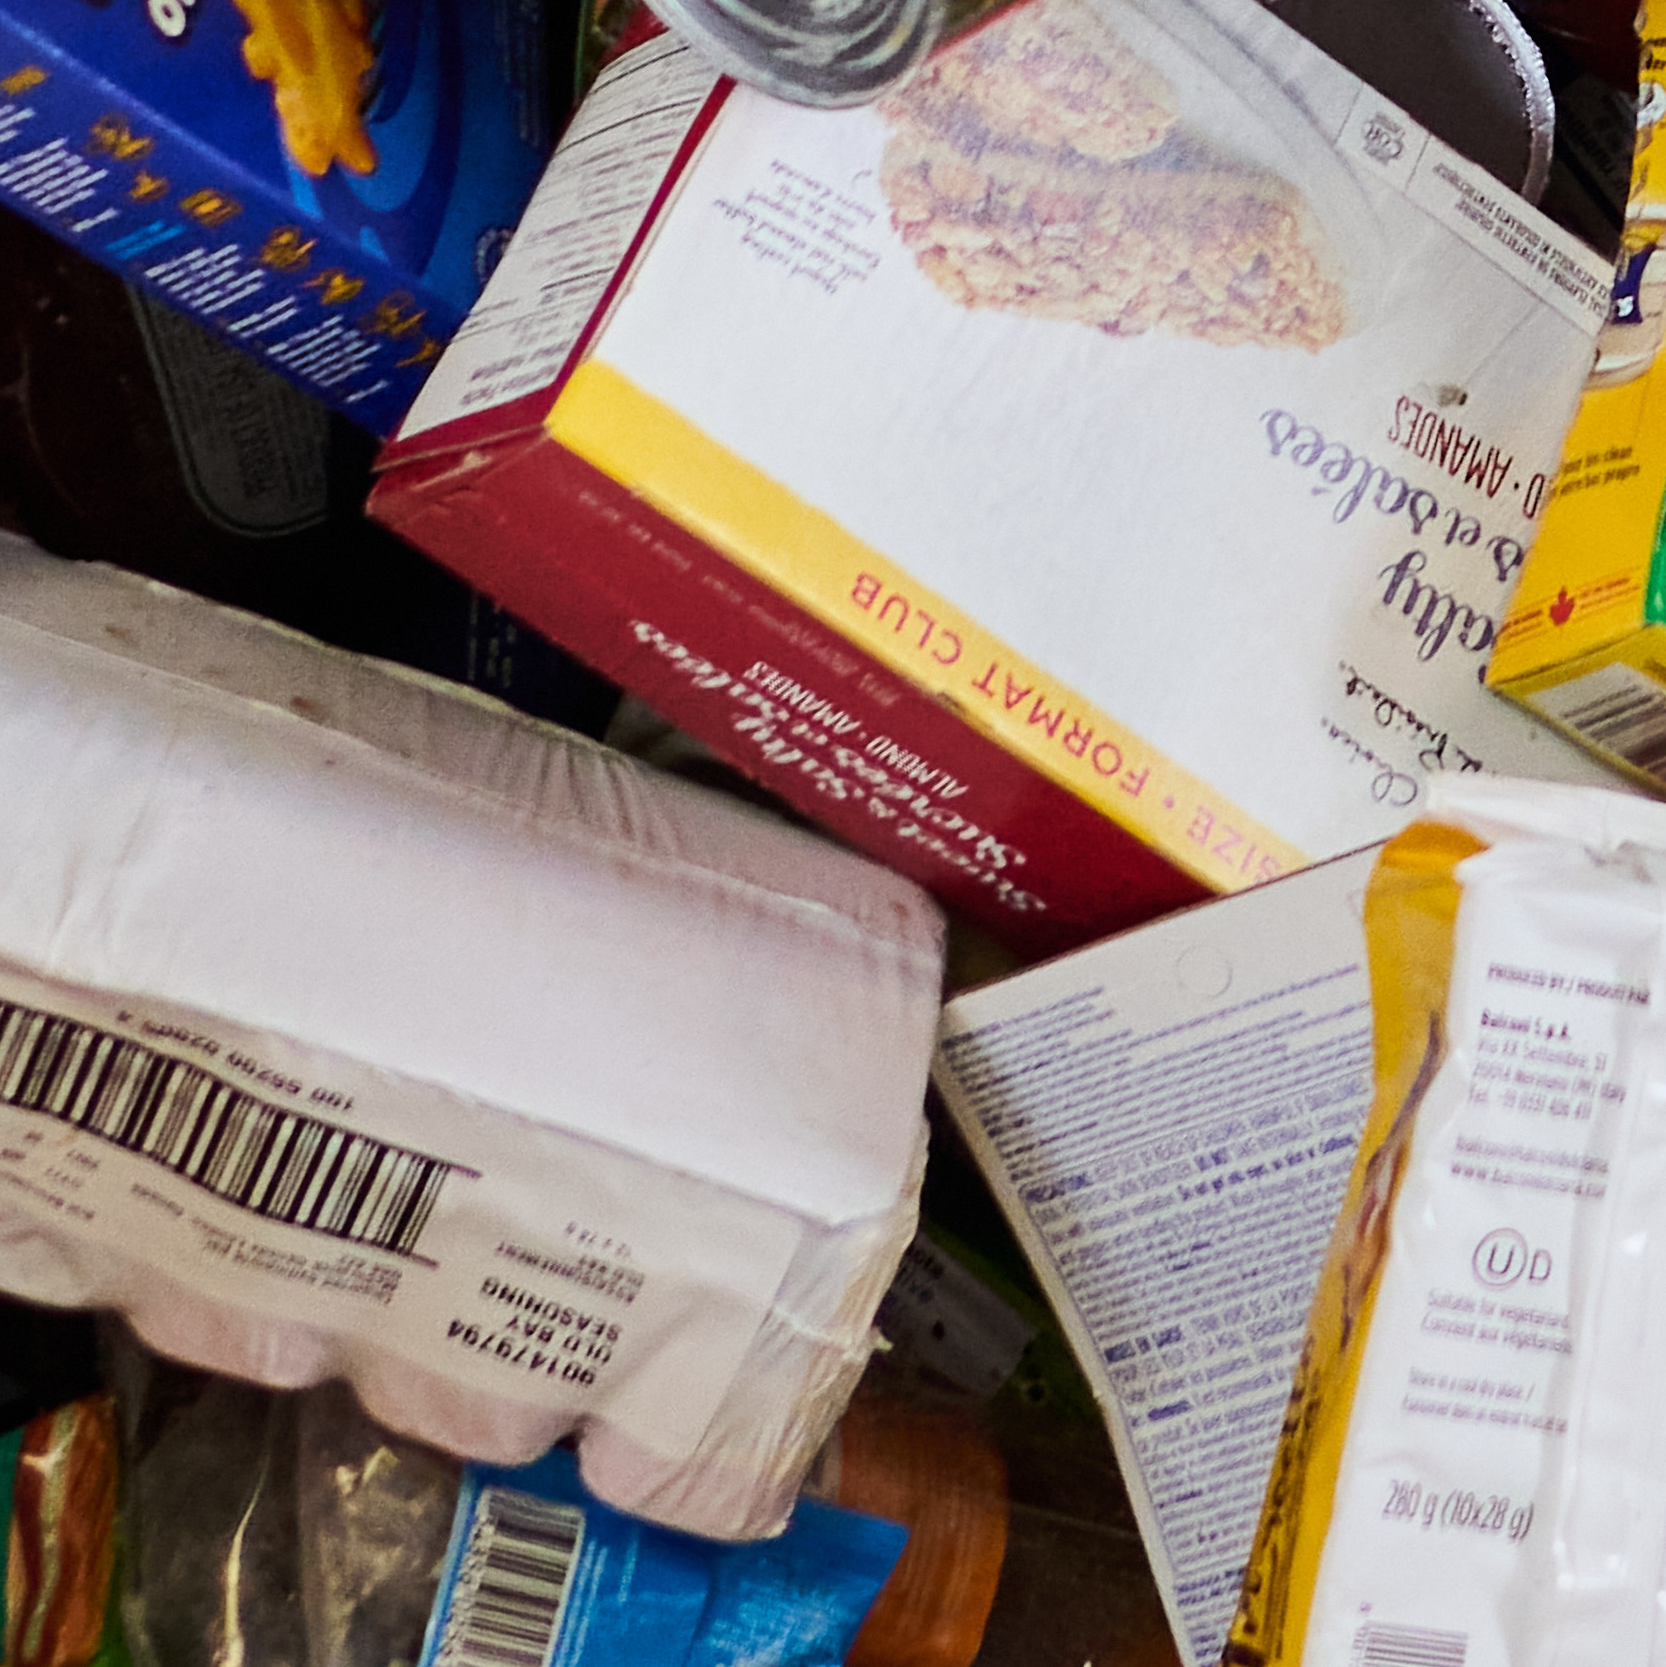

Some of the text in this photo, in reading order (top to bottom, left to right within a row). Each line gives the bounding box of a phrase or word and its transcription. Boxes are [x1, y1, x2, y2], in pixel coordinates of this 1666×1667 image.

[1254, 407, 1484, 552] et salées
[1389, 396, 1514, 489] AMANDES
[844, 569, 968, 668] CLUB
[729, 710, 865, 797] Salty
[742, 658, 968, 798] ALMOND AMANDES
[970, 657, 1154, 797] FORMAT
[829, 744, 1026, 868] Sucrées
[480, 1275, 621, 1341] SEASONING
[505, 1314, 612, 1363] OLD BAY
[1383, 1479, 1535, 1541] 280 g (10x28 g)
